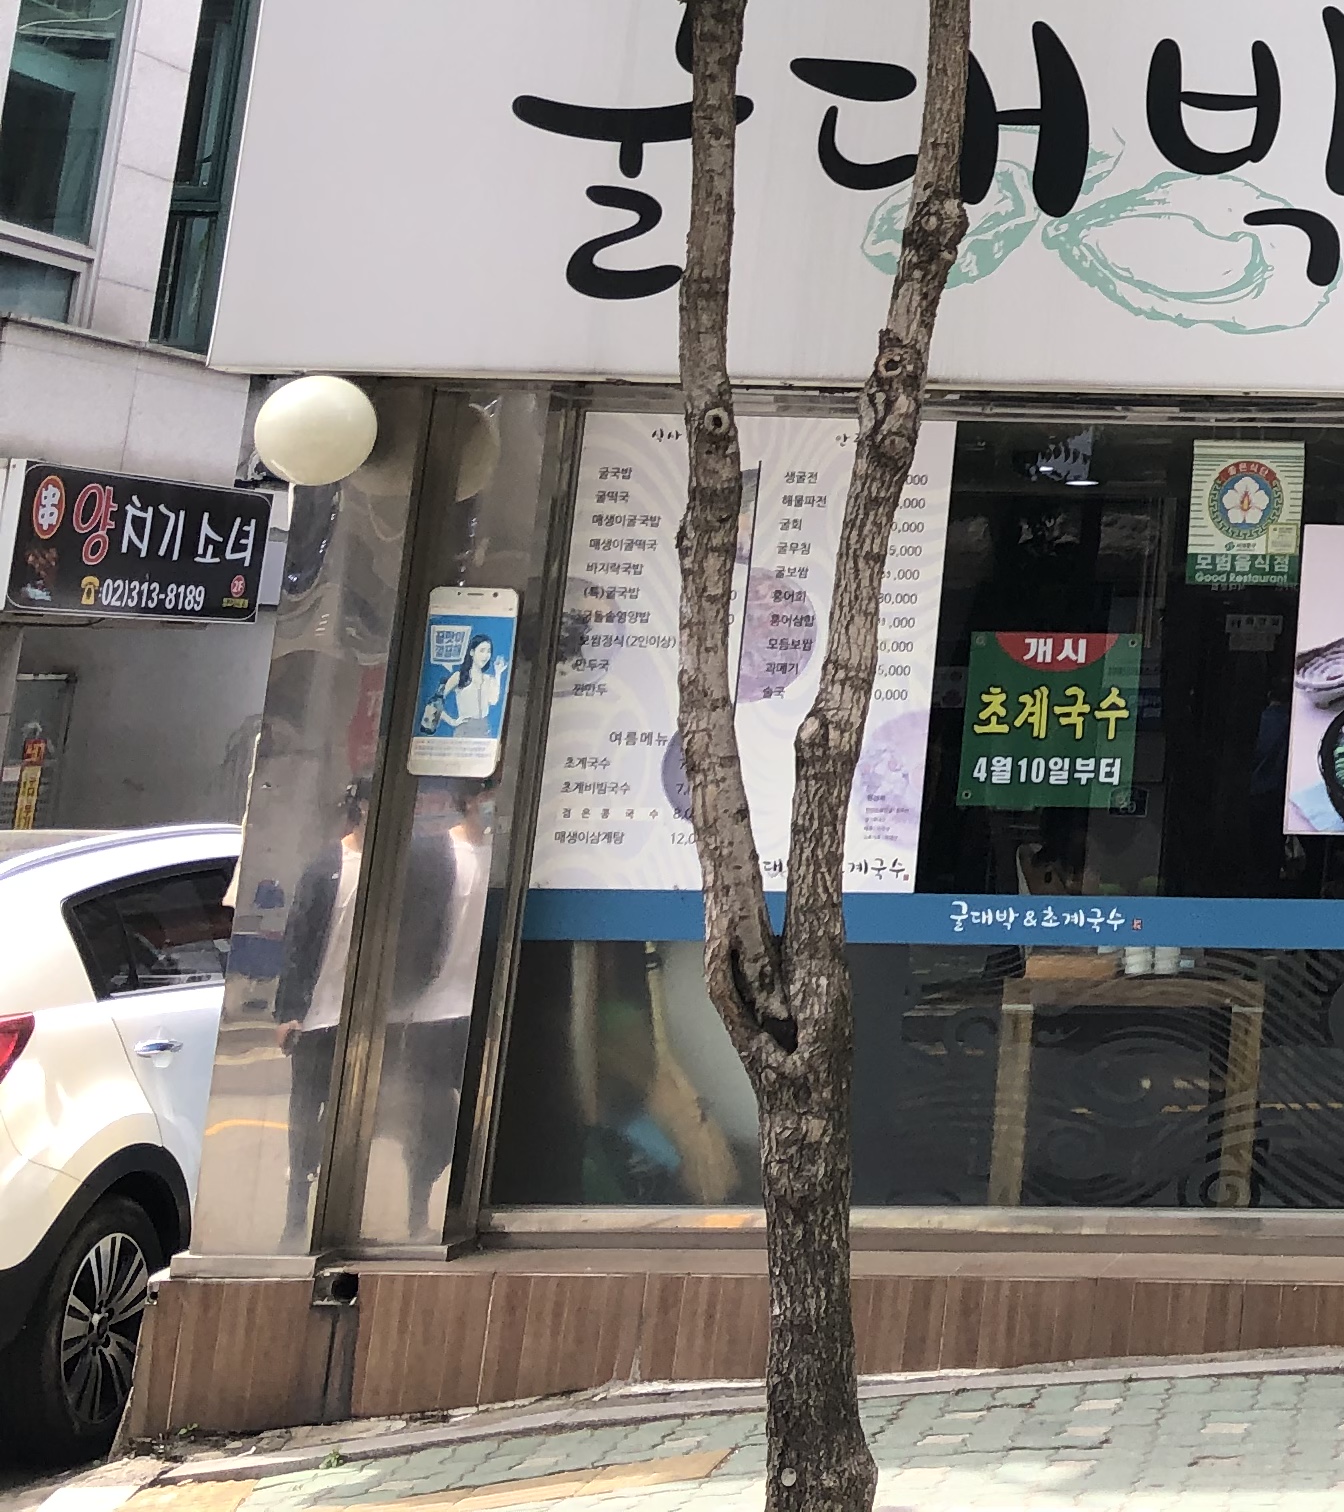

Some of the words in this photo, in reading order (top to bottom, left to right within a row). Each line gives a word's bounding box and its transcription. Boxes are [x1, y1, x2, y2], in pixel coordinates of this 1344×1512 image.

[652, 428, 682, 442] 식사
[598, 467, 632, 480] 굴국밥
[784, 471, 818, 484] 생굴전
[595, 490, 629, 504] 굴떡국
[781, 495, 827, 508] 해물파전
[73, 483, 185, 565] 양치기
[194, 511, 256, 567] 소녀
[591, 514, 662, 528] 매생이굴국밥
[779, 518, 802, 531] 굴회
[890, 522, 924, 533] 0,000
[589, 538, 659, 552] 매생이굴떡국
[777, 542, 811, 556] 굴무침
[586, 562, 644, 575] 바지락국밥
[1195, 554, 1289, 572] 모범음식점
[774, 566, 809, 579] 굴보쌈
[1195, 572, 1226, 583] Good
[1229, 572, 1288, 583] Restaurant
[102, 578, 206, 611] 02)313-8189
[772, 590, 806, 603] 홍어회
[770, 613, 815, 627] 홍어삼합
[767, 638, 813, 652] 모듬보쌈
[879, 641, 914, 653] 0,000
[1023, 638, 1087, 664] 개시
[765, 663, 799, 675] 과메기
[874, 689, 908, 701] 0,000
[973, 685, 1130, 740] 초계국수
[609, 731, 669, 747] 여름메뉴
[564, 757, 610, 770] 초계국수
[973, 756, 1012, 784] 4월
[1017, 757, 1122, 786] 10일부터
[560, 782, 631, 795] 초계비빔국수
[554, 831, 625, 845] 매생이삼계탕
[671, 832, 696, 846] 12,0
[849, 858, 906, 880] 계국수
[950, 900, 1020, 932] 굴대박
[1023, 909, 1038, 928] &
[1040, 905, 1126, 933] 초계국수
